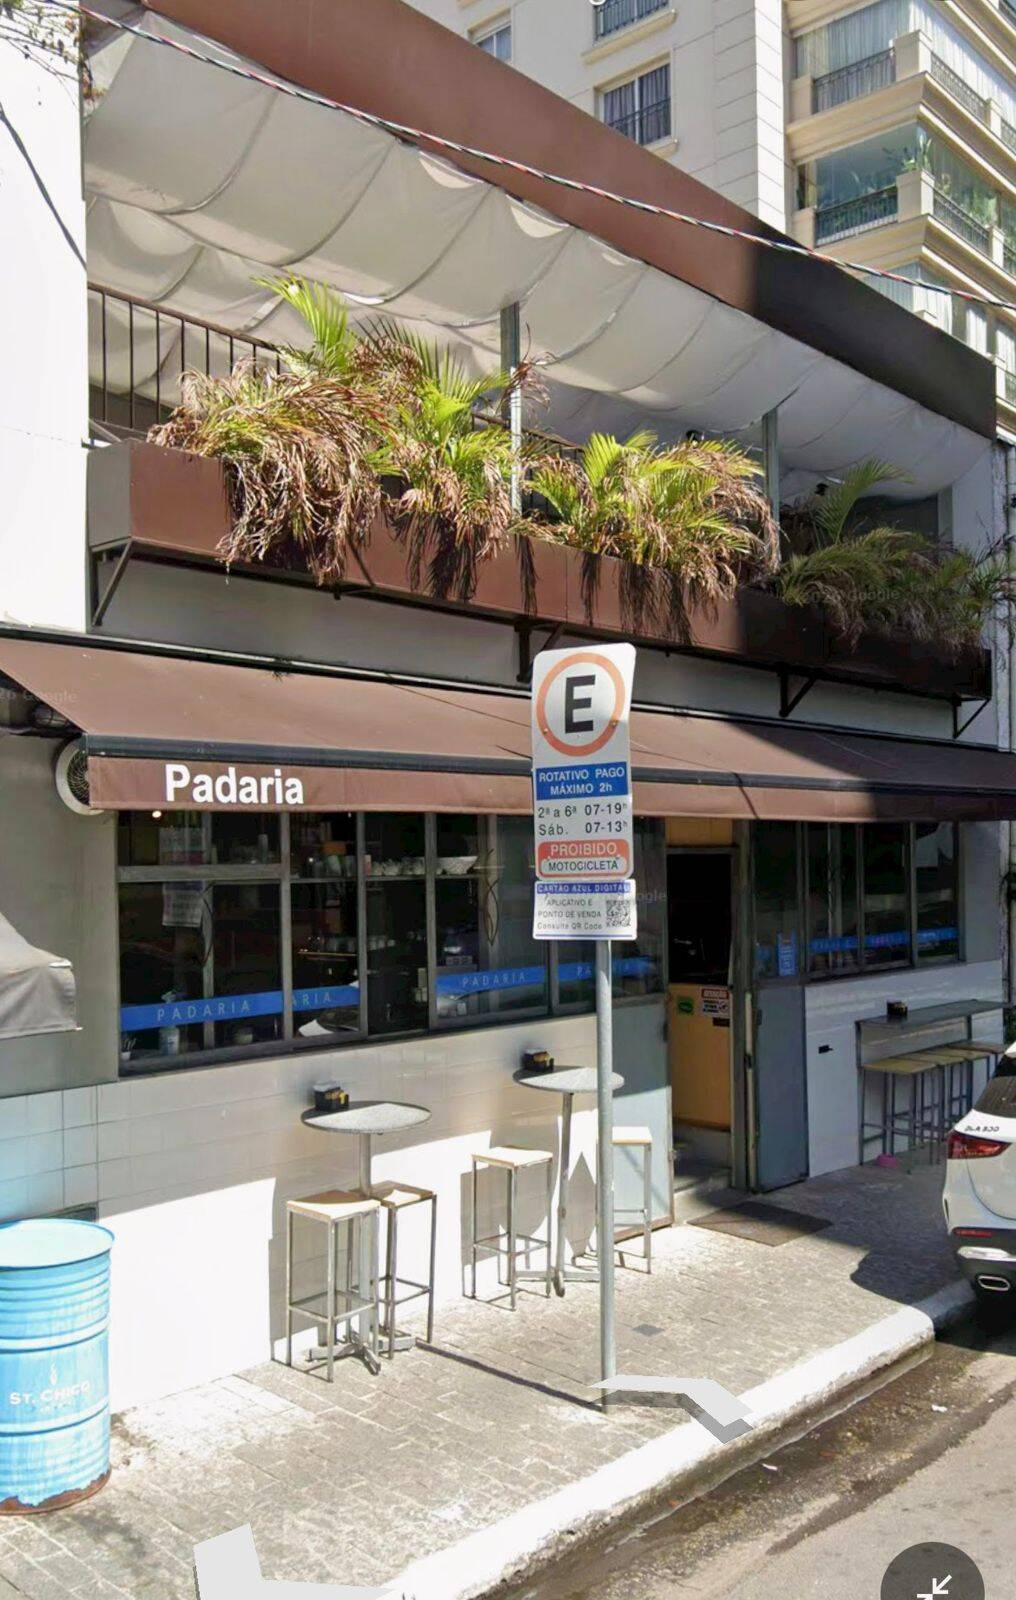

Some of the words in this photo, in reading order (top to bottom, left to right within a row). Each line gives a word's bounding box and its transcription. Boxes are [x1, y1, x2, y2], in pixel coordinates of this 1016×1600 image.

[564, 674, 596, 734] E
[539, 768, 589, 783] ROTATIVO
[594, 766, 625, 779] PAGO
[164, 762, 305, 805] Padaria
[550, 782, 594, 796] MÁXIMO
[599, 782, 613, 793] 2h
[553, 808, 560, 818] a
[538, 823, 569, 836] Sáb.
[550, 841, 617, 857] PROIBIDO
[548, 859, 619, 872] MOTOCICLETA
[571, 883, 592, 892] AZUL
[547, 899, 587, 907] APLICATIVO
[537, 910, 564, 919] PONTO
[565, 910, 576, 918] DE
[577, 910, 602, 918] VENDA
[461, 971, 526, 988] PADARIA
[156, 999, 252, 1022] PADARIA
[9, 1391, 36, 1405] ST.
[40, 1380, 91, 1402] CHICO
